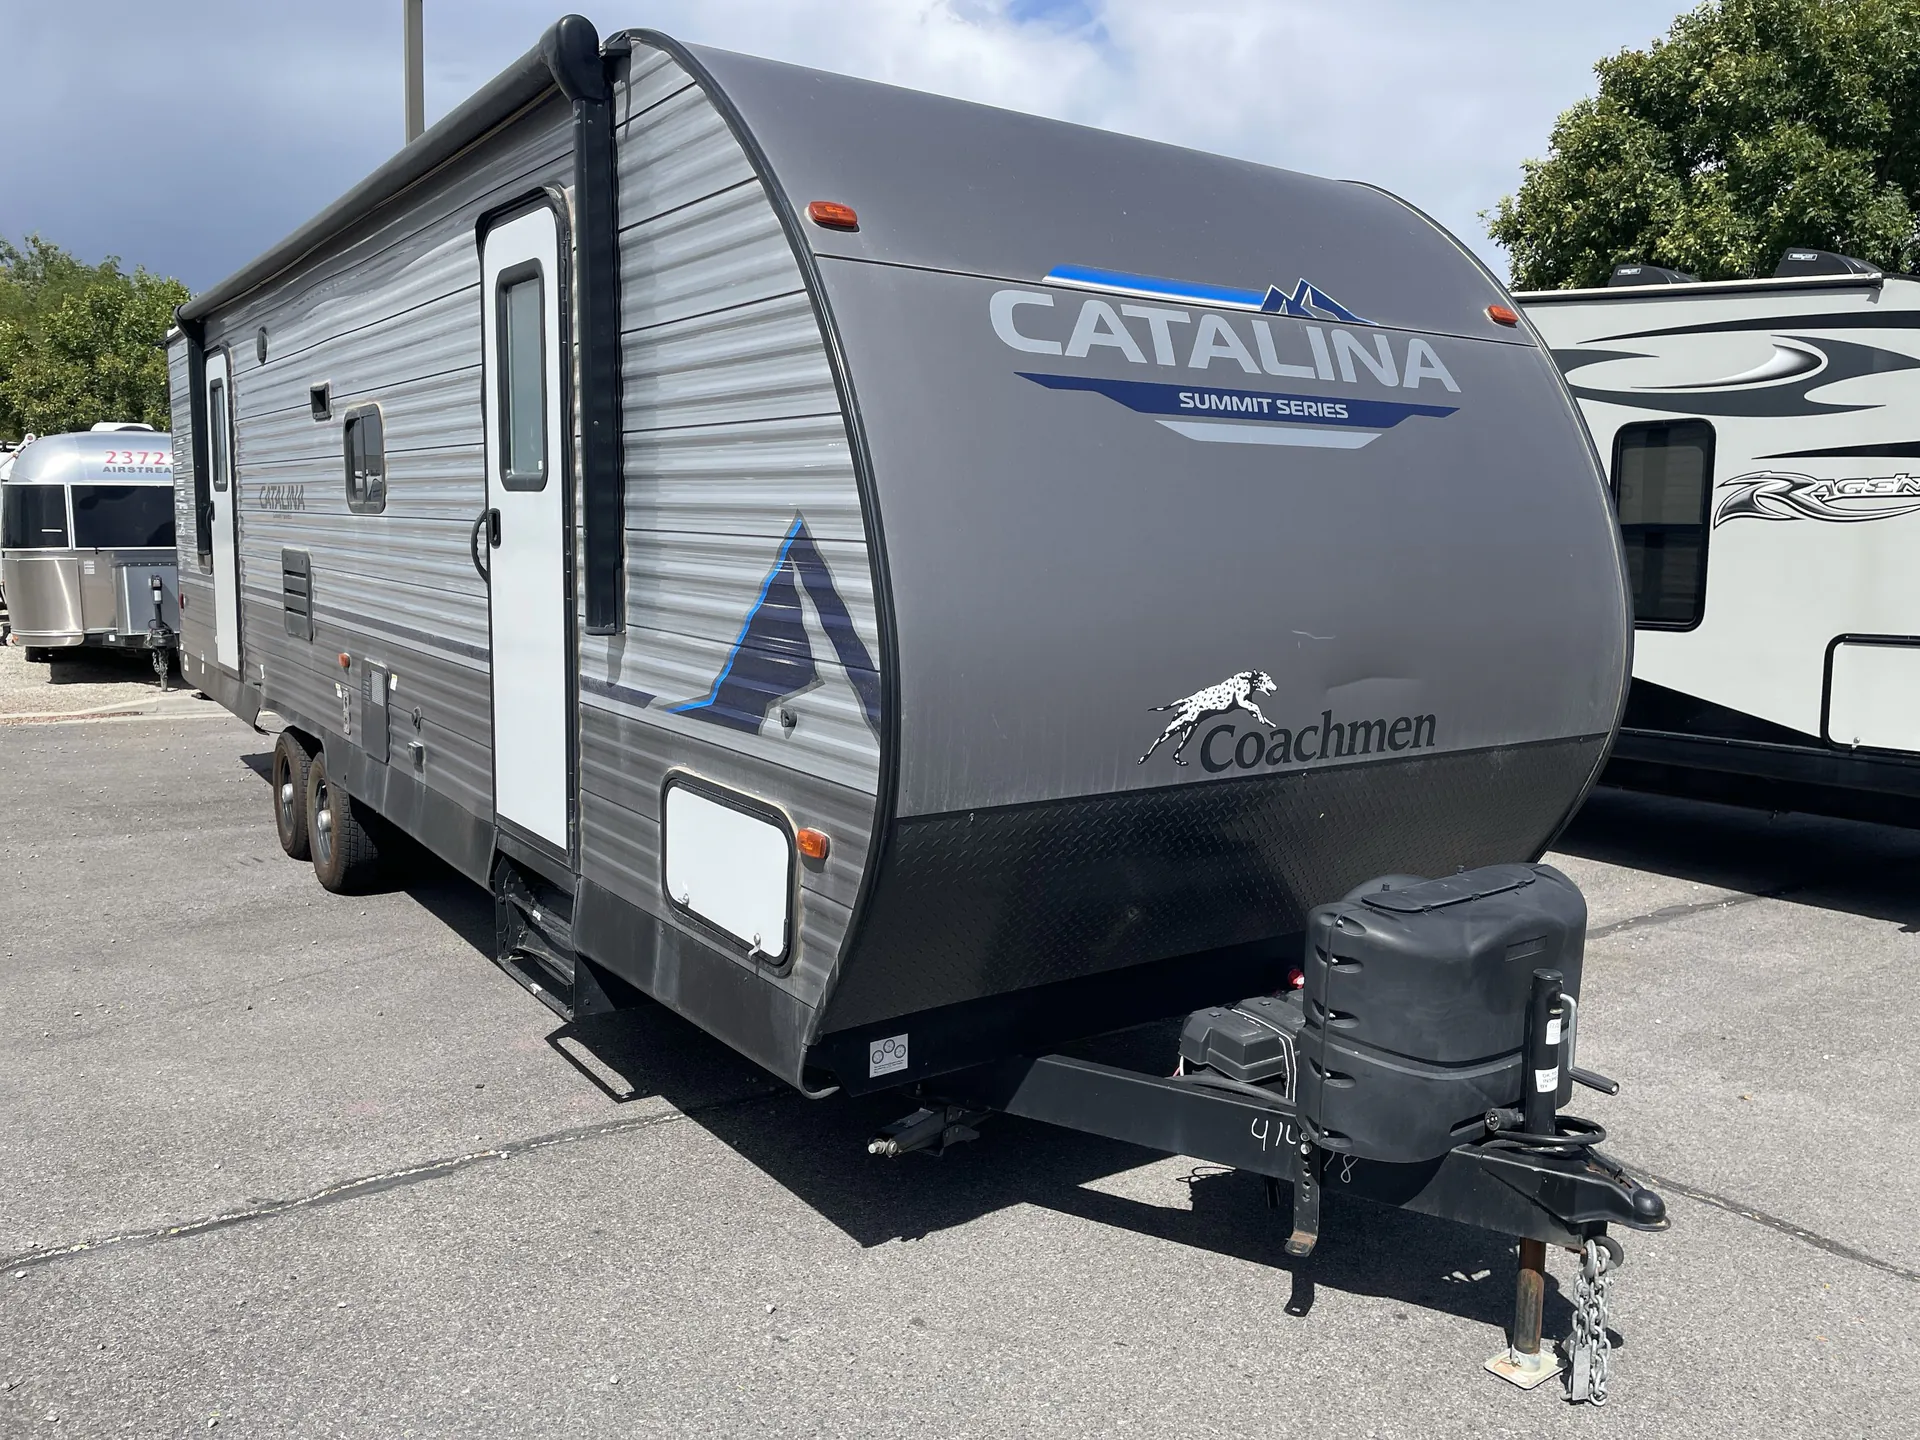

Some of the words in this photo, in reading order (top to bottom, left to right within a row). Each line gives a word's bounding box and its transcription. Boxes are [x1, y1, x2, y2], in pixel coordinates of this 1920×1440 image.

[989, 288, 1462, 394] CATALINA
[1178, 391, 1273, 415] SUMMIT
[1276, 399, 1349, 420] SERIES
[105, 450, 174, 466] 2372
[259, 484, 306, 511] CATALINA
[1199, 709, 1437, 774] Coachmen
